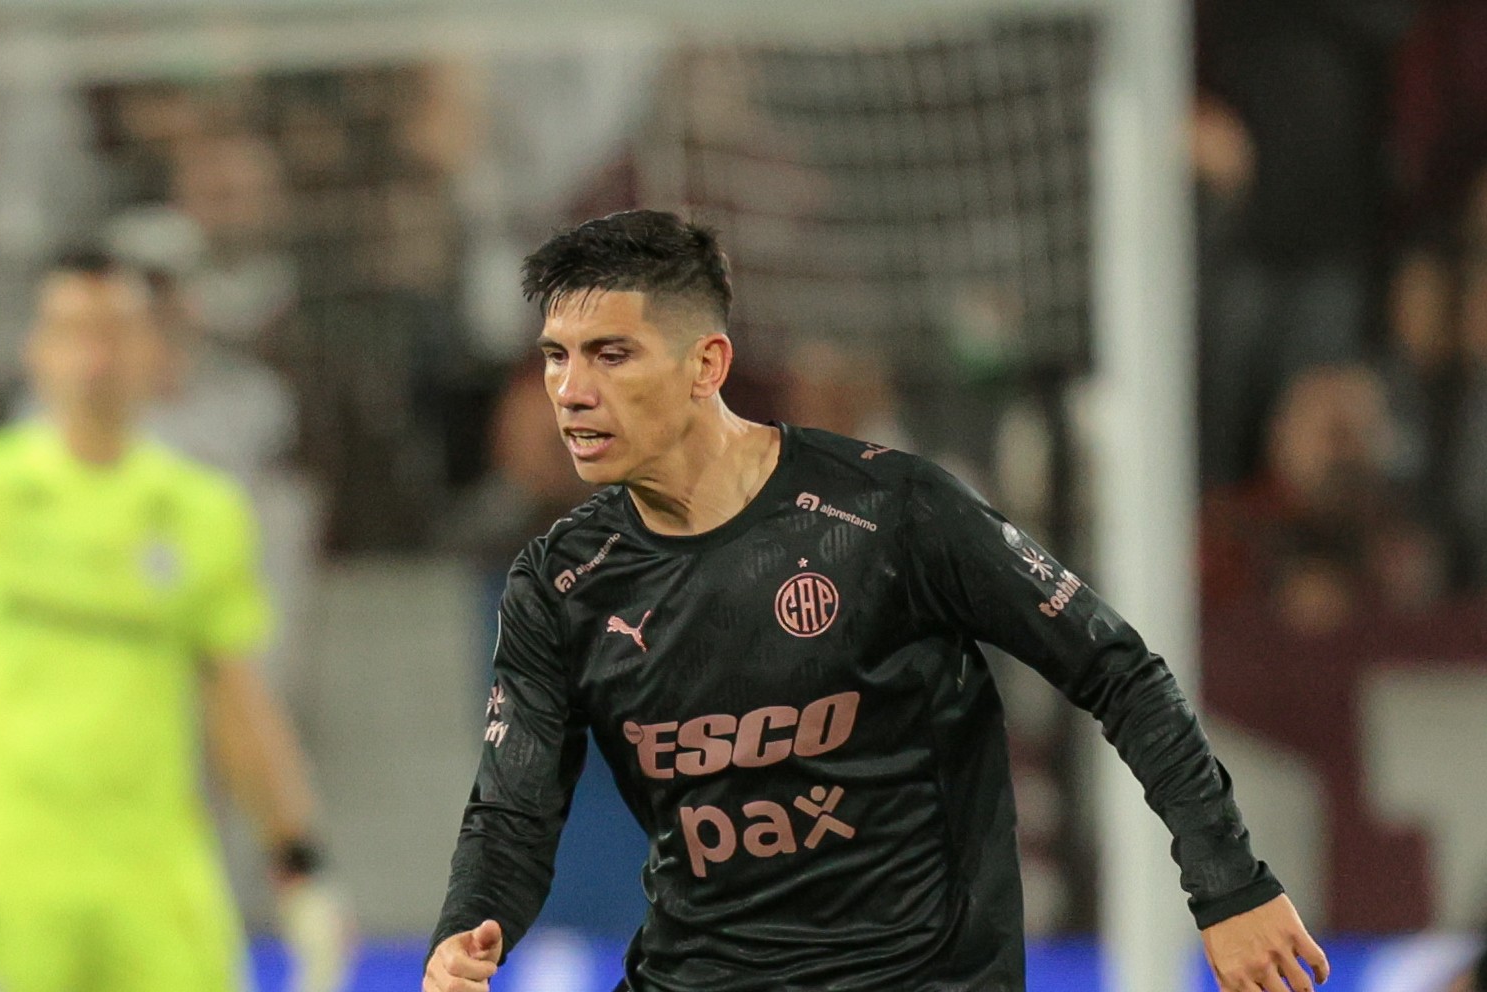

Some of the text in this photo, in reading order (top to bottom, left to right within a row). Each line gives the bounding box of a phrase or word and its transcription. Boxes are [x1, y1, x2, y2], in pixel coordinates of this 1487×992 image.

[820, 504, 878, 532] alprestamo
[777, 576, 835, 632] CAP
[636, 690, 861, 780] ESCO
[678, 785, 857, 879] pax
